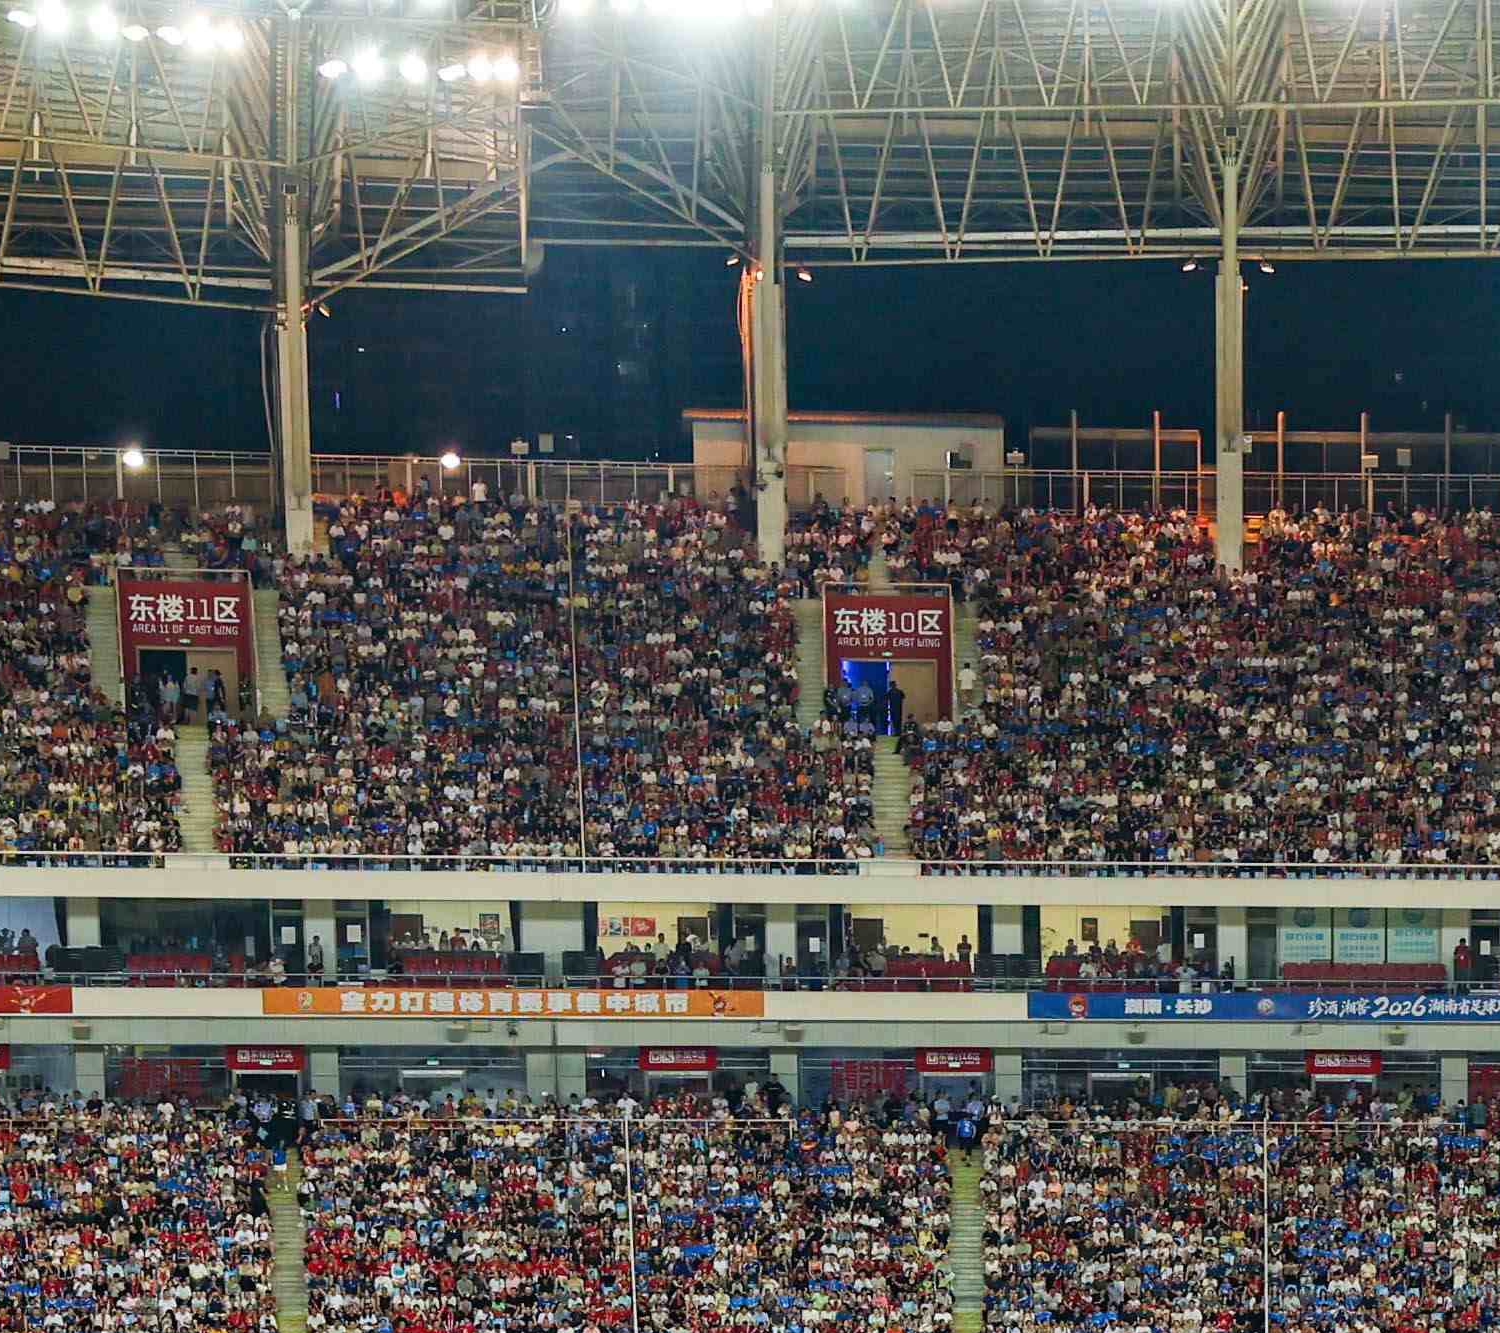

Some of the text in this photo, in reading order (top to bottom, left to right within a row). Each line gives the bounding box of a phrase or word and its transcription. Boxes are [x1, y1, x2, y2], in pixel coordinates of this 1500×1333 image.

[129, 594, 240, 623] 东楼11区
[133, 624, 238, 635] AREA 11 OF EAST WING
[834, 608, 943, 635] 东楼10区
[838, 637, 940, 648] AREA 10 OF EAST WING
